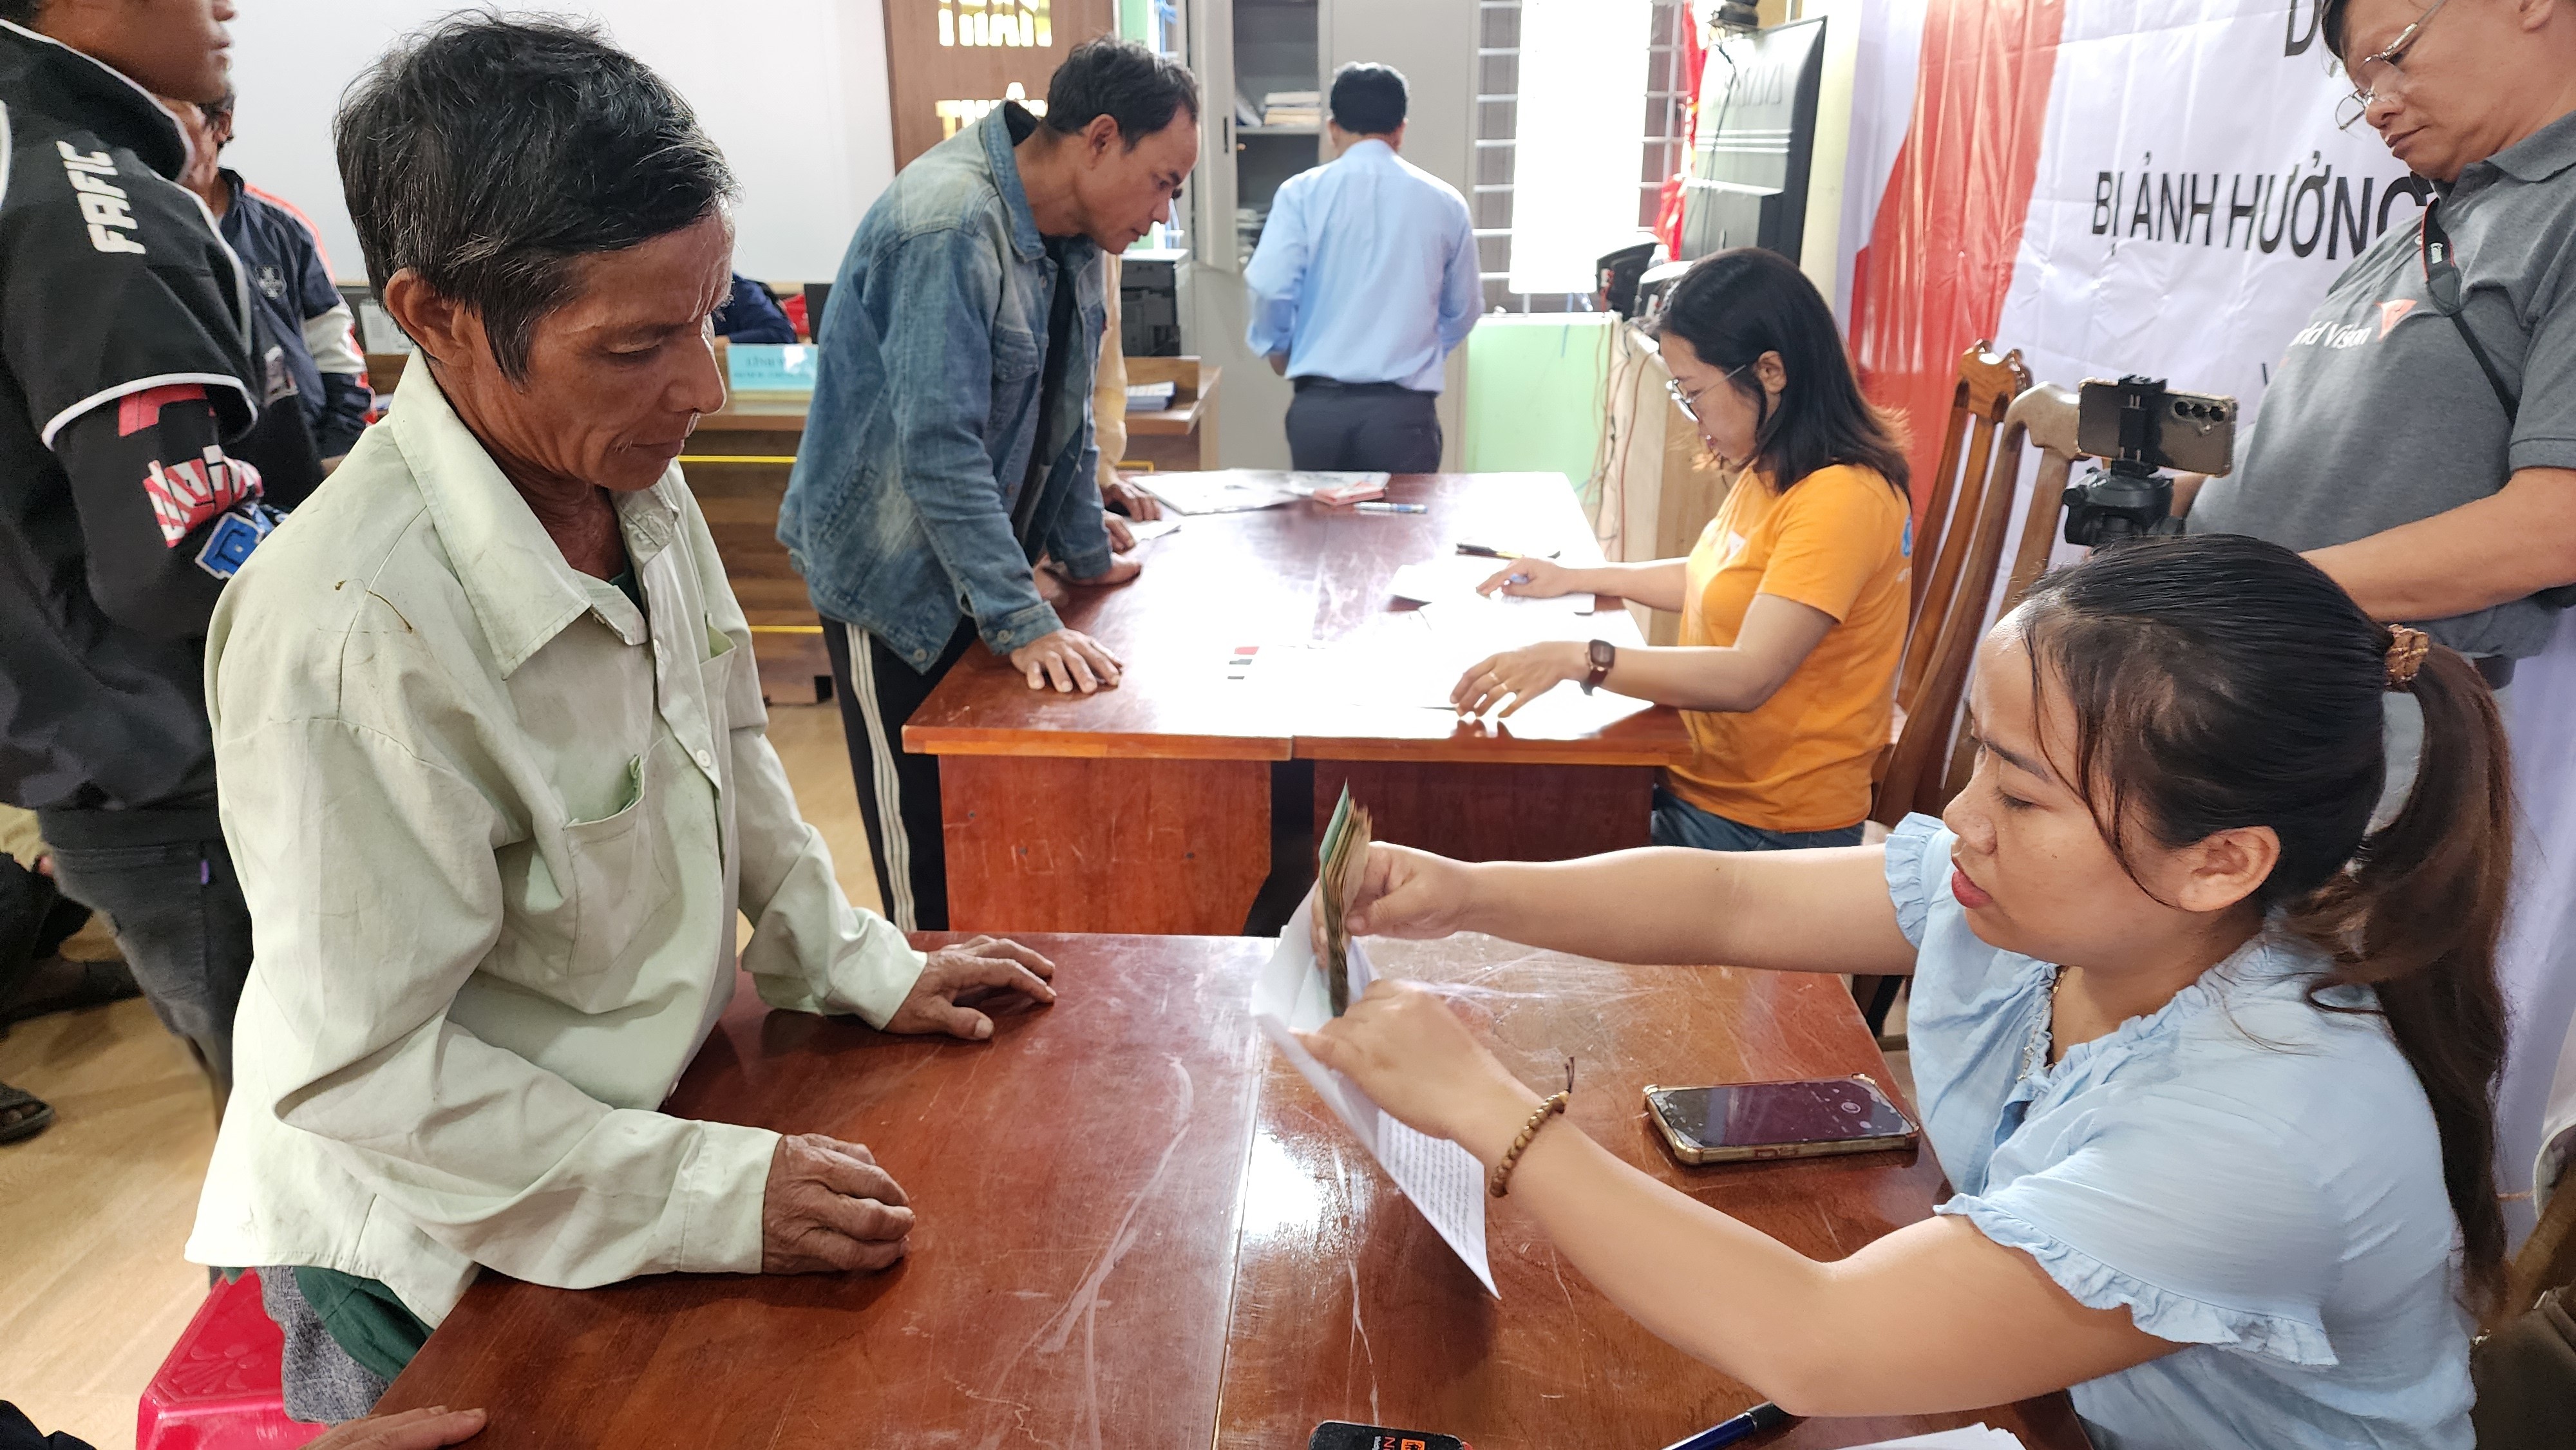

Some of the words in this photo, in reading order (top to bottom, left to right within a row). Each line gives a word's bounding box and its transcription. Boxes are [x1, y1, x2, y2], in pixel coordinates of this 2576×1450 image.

[55, 140, 146, 254] FAFIC
[2092, 171, 2125, 256] BỊ
[2130, 151, 2219, 246] ẢNH
